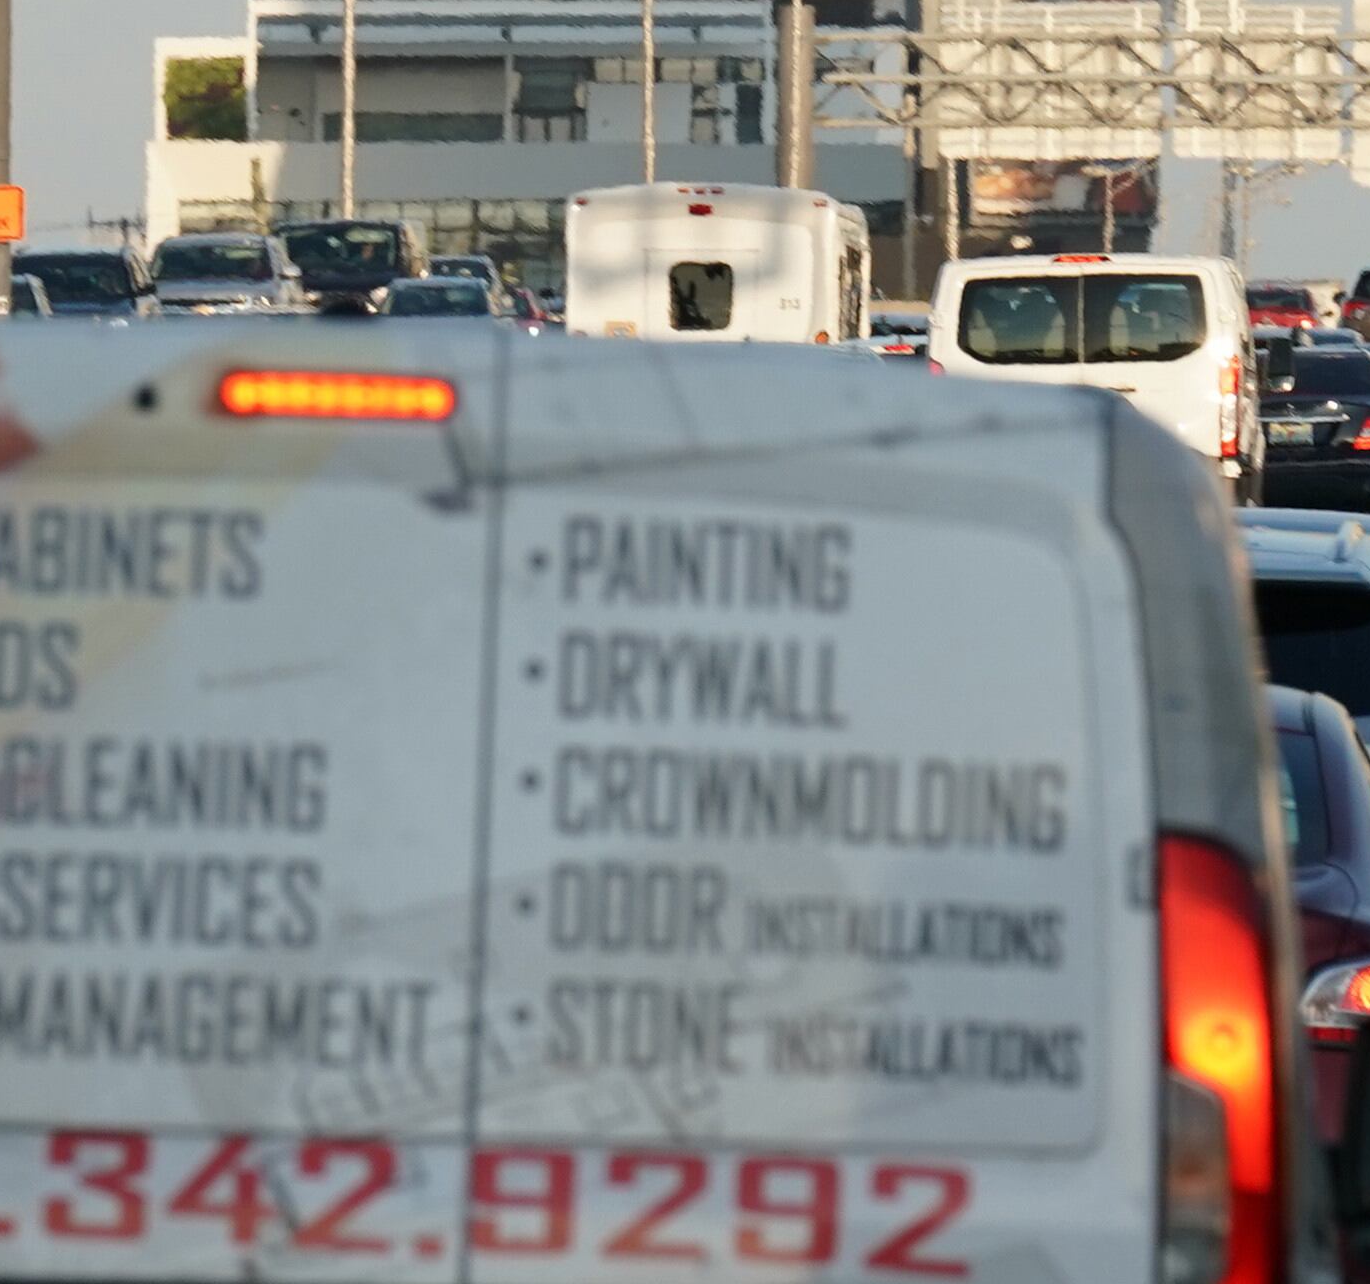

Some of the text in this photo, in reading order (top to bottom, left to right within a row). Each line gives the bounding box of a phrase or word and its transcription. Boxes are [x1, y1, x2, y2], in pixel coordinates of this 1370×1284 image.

[560, 514, 852, 614] PAINTING
[558, 628, 847, 731] DRYWALL
[553, 744, 1069, 854] CROWNMOLDING
[747, 894, 1067, 973] INSTALLATIONS
[547, 978, 1085, 1088] STONE INSTALLATIONS
